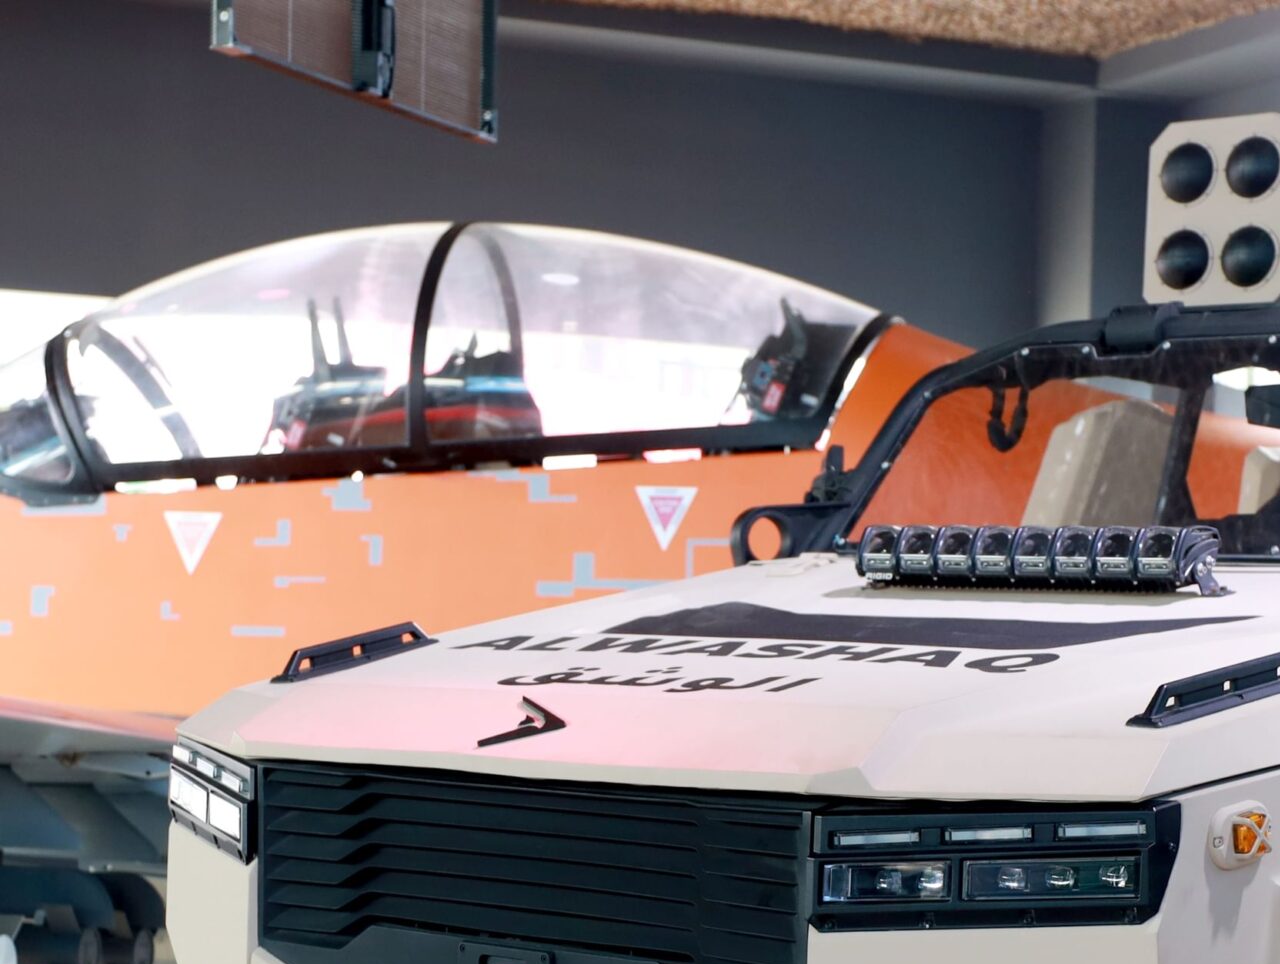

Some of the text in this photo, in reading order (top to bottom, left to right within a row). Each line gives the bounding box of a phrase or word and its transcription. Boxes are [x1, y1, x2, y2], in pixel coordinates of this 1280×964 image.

[865, 572, 893, 581] RIGID
[450, 635, 1060, 673] ALWASHAQ
[497, 666, 823, 692] الوشق
